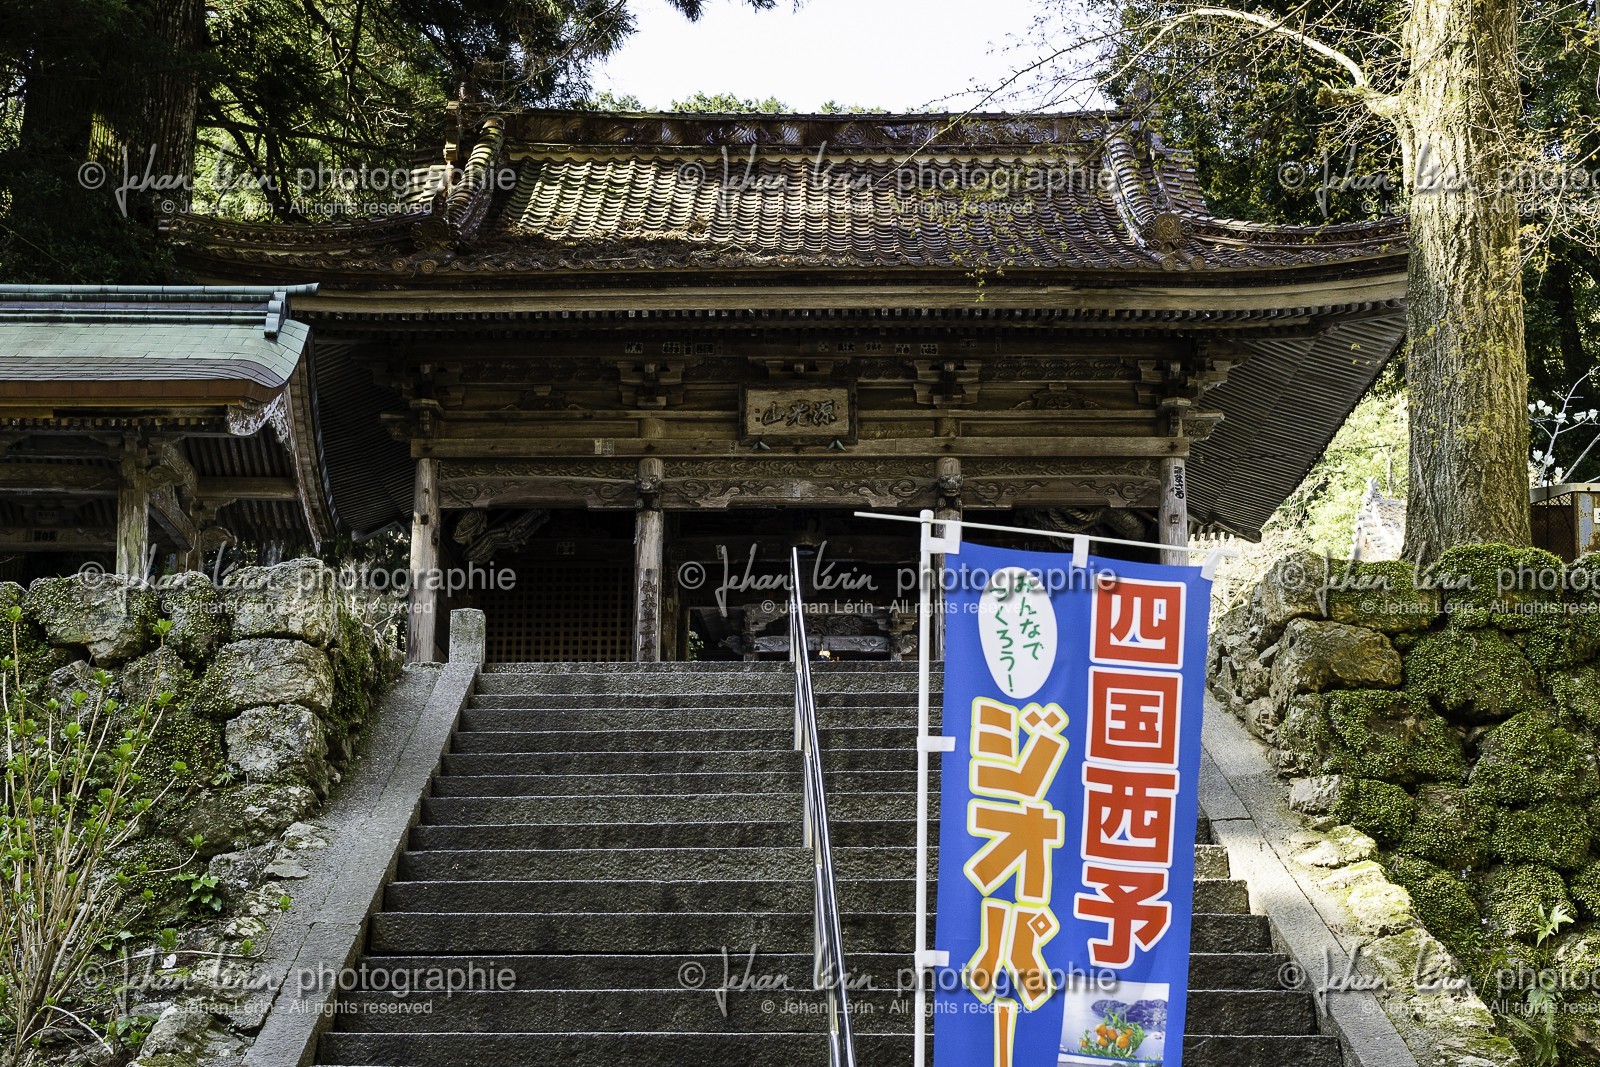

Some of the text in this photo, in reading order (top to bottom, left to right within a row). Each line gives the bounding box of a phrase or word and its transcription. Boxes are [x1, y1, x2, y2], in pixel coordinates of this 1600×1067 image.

[1015, 575, 1044, 660] みんなで
[1074, 577, 1187, 969] 四国西予
